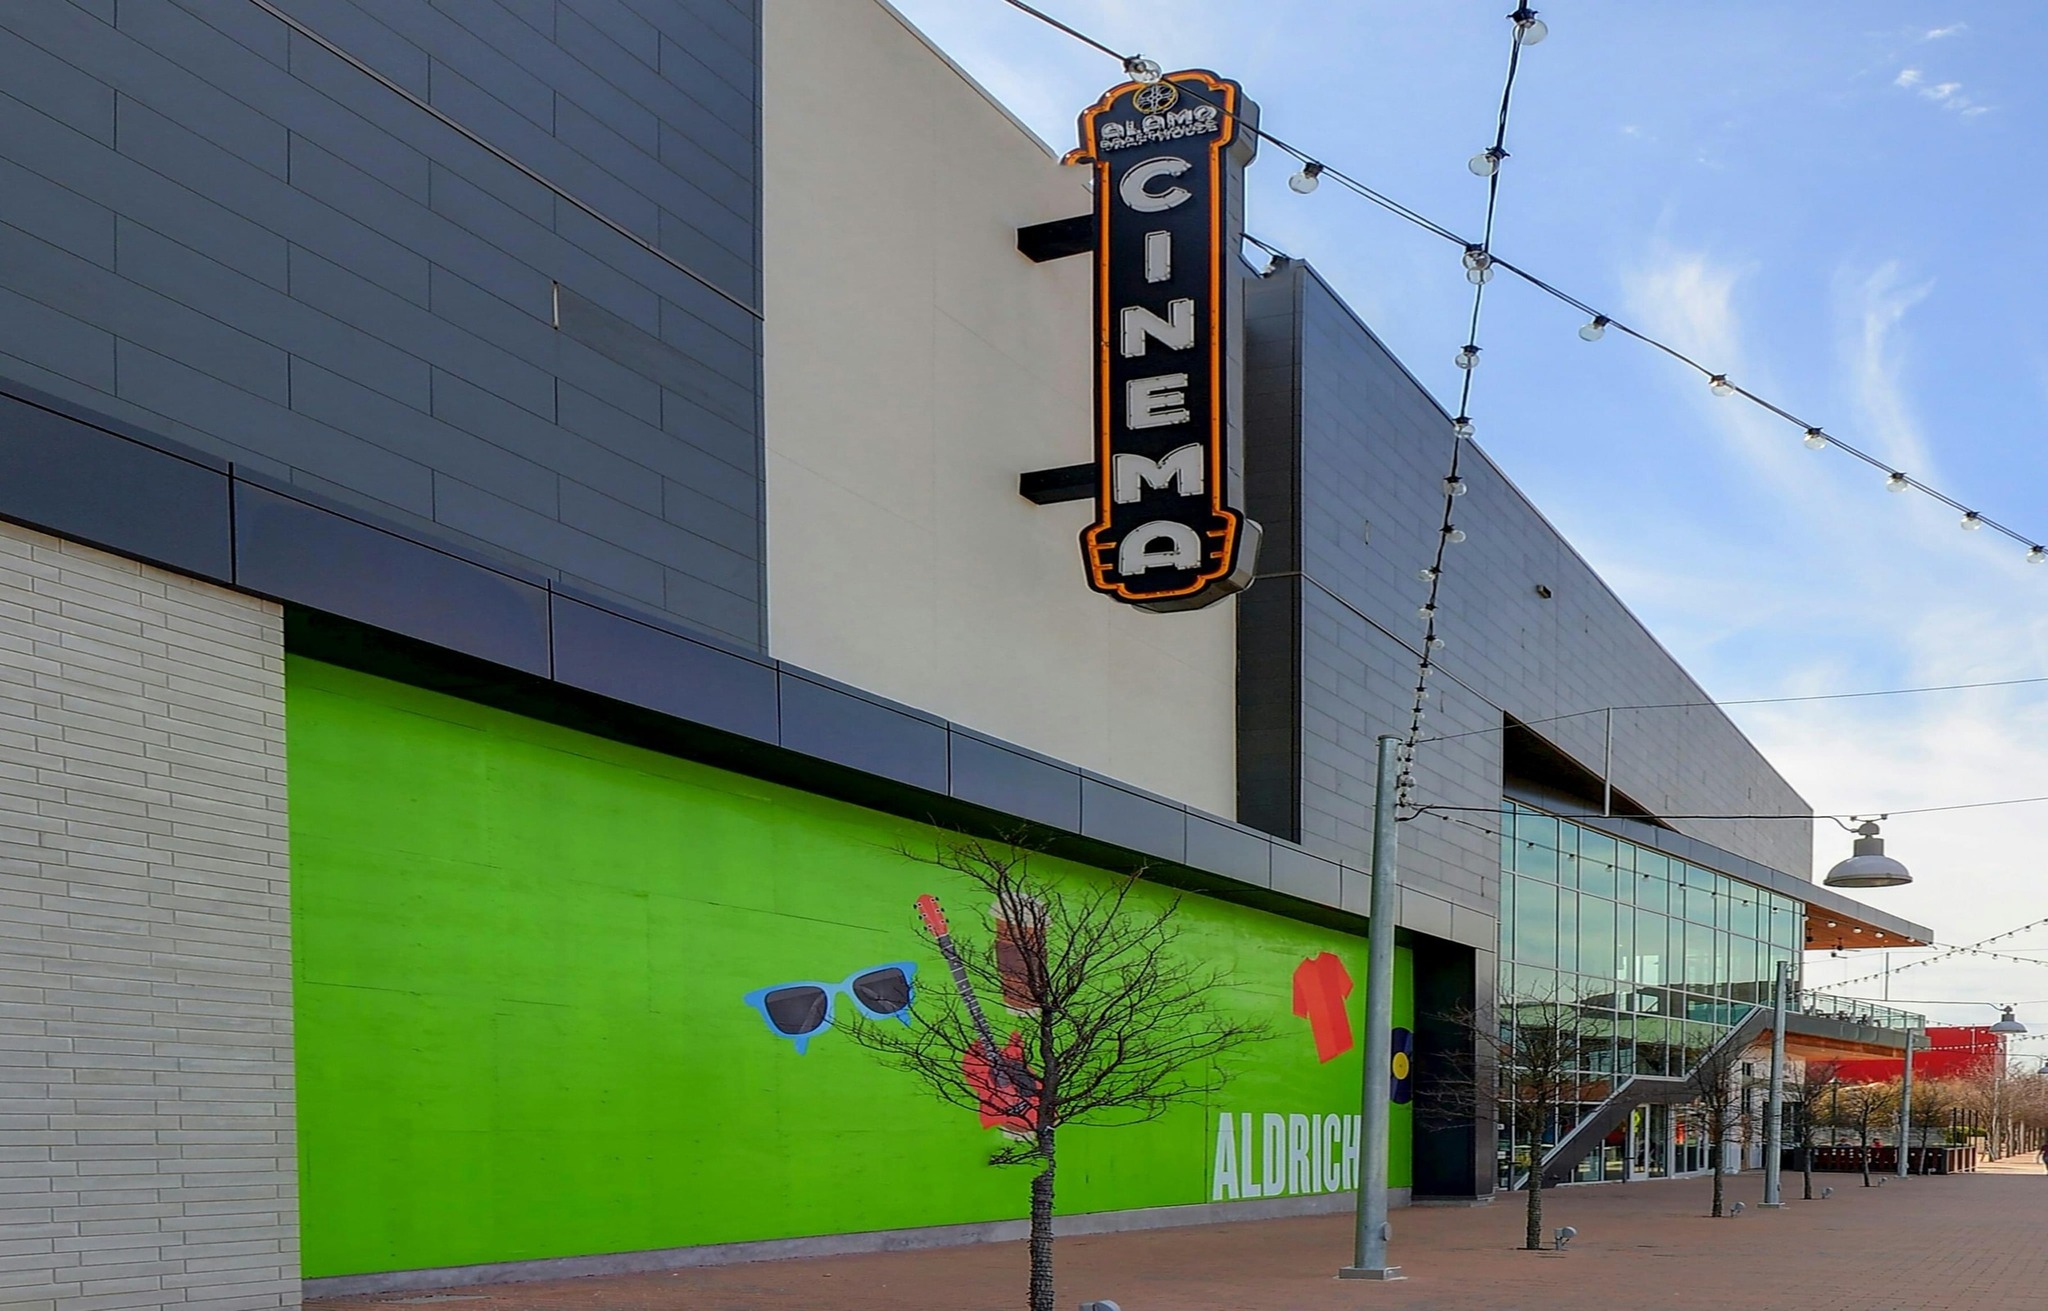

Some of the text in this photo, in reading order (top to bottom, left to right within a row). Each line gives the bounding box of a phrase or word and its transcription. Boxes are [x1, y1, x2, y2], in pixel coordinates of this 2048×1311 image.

[1101, 105, 1217, 139] ALAMO
[1112, 156, 1205, 576] CINEMA
[1213, 1112, 1362, 1200] ALDRICH
